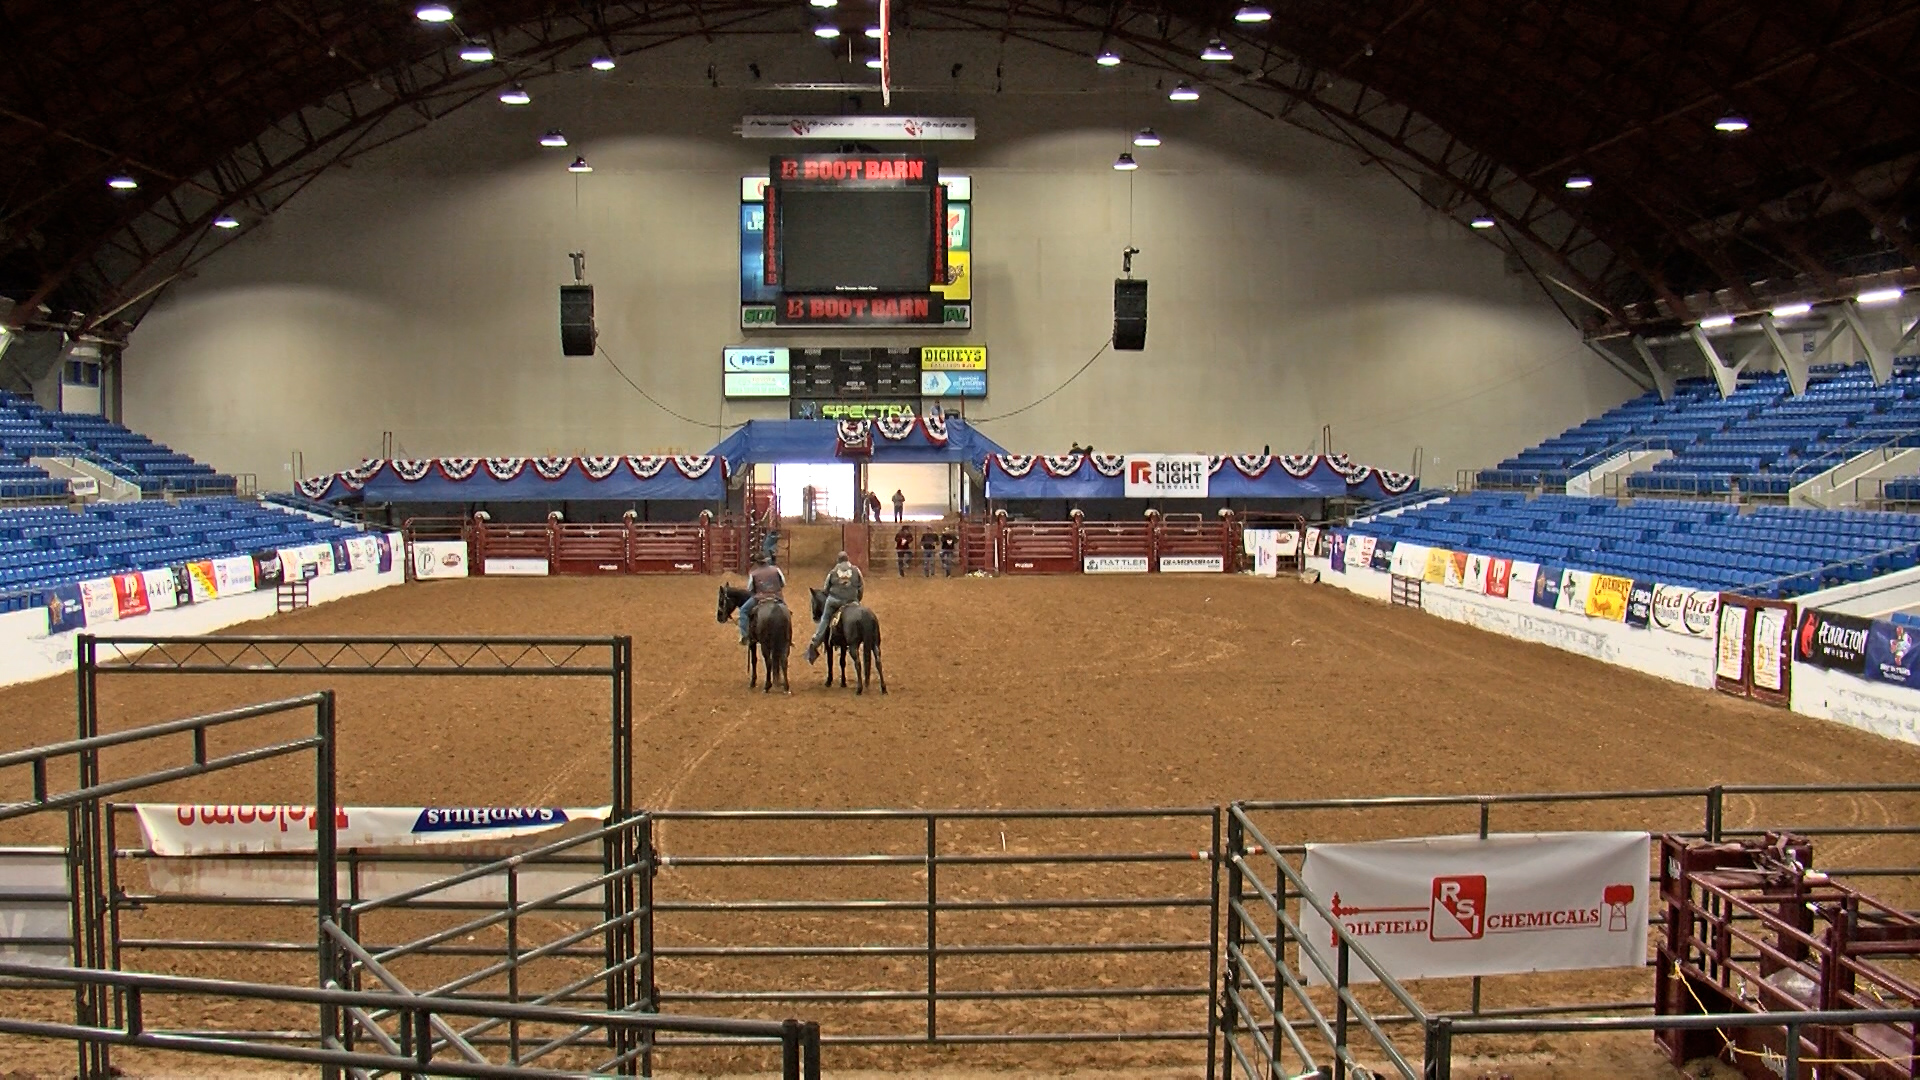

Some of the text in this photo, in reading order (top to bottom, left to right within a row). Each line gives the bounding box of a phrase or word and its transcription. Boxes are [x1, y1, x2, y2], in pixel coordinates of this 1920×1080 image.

[804, 160, 862, 180] BOOT
[865, 159, 923, 180] BARN
[810, 299, 868, 318] BOOT
[871, 299, 929, 318] BARN
[822, 404, 915, 419] SPECTRA
[1156, 461, 1202, 473] RIGHT
[1156, 472, 1202, 484] LIGHT
[1818, 621, 1869, 655] PENDLETON
[1823, 647, 1855, 660] WHISKY
[1487, 908, 1600, 930] CHEMICALS
